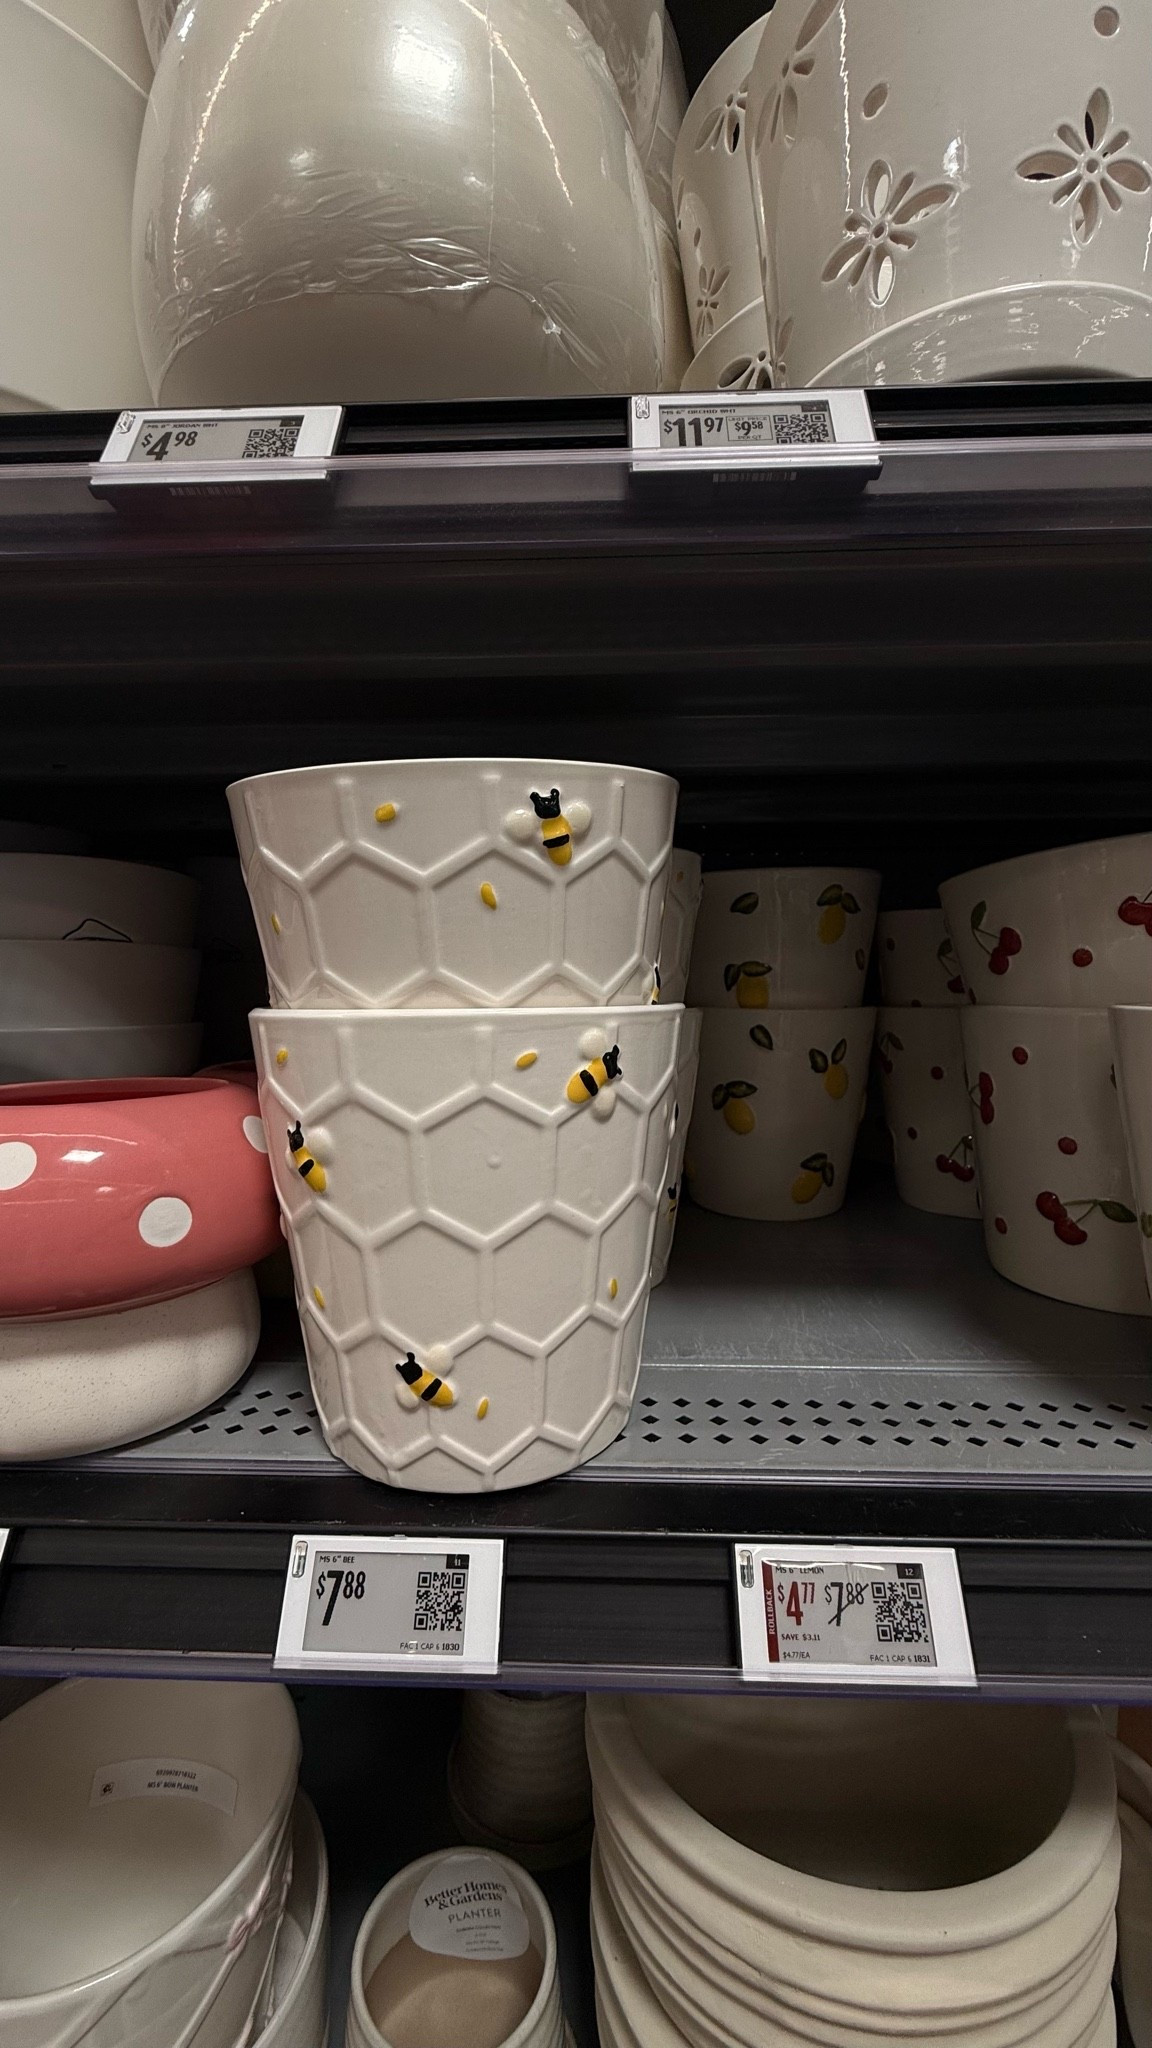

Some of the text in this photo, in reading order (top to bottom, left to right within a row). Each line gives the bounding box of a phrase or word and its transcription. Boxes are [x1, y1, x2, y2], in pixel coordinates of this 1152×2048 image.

[319, 1555, 330, 1563] MS
[342, 1556, 355, 1564] BEE
[799, 1566, 825, 1574] LEMON
[904, 1568, 915, 1576] 12
[767, 1588, 777, 1635] ROLLBACK
[781, 1633, 821, 1641] SAVE $3.11
[400, 1642, 413, 1650] FAC
[420, 1642, 434, 1650] CAP
[441, 1642, 460, 1651] 1830
[783, 1651, 811, 1659] $4.77/EA
[870, 1654, 884, 1662] FAC
[891, 1654, 906, 1662] CAP
[914, 1654, 931, 1663] 1831
[177, 1782, 199, 1792] PLANTER
[424, 1881, 508, 1908] Better Homes
[438, 1891, 503, 1910] & Gardens
[448, 1908, 502, 1923] PLANTER
